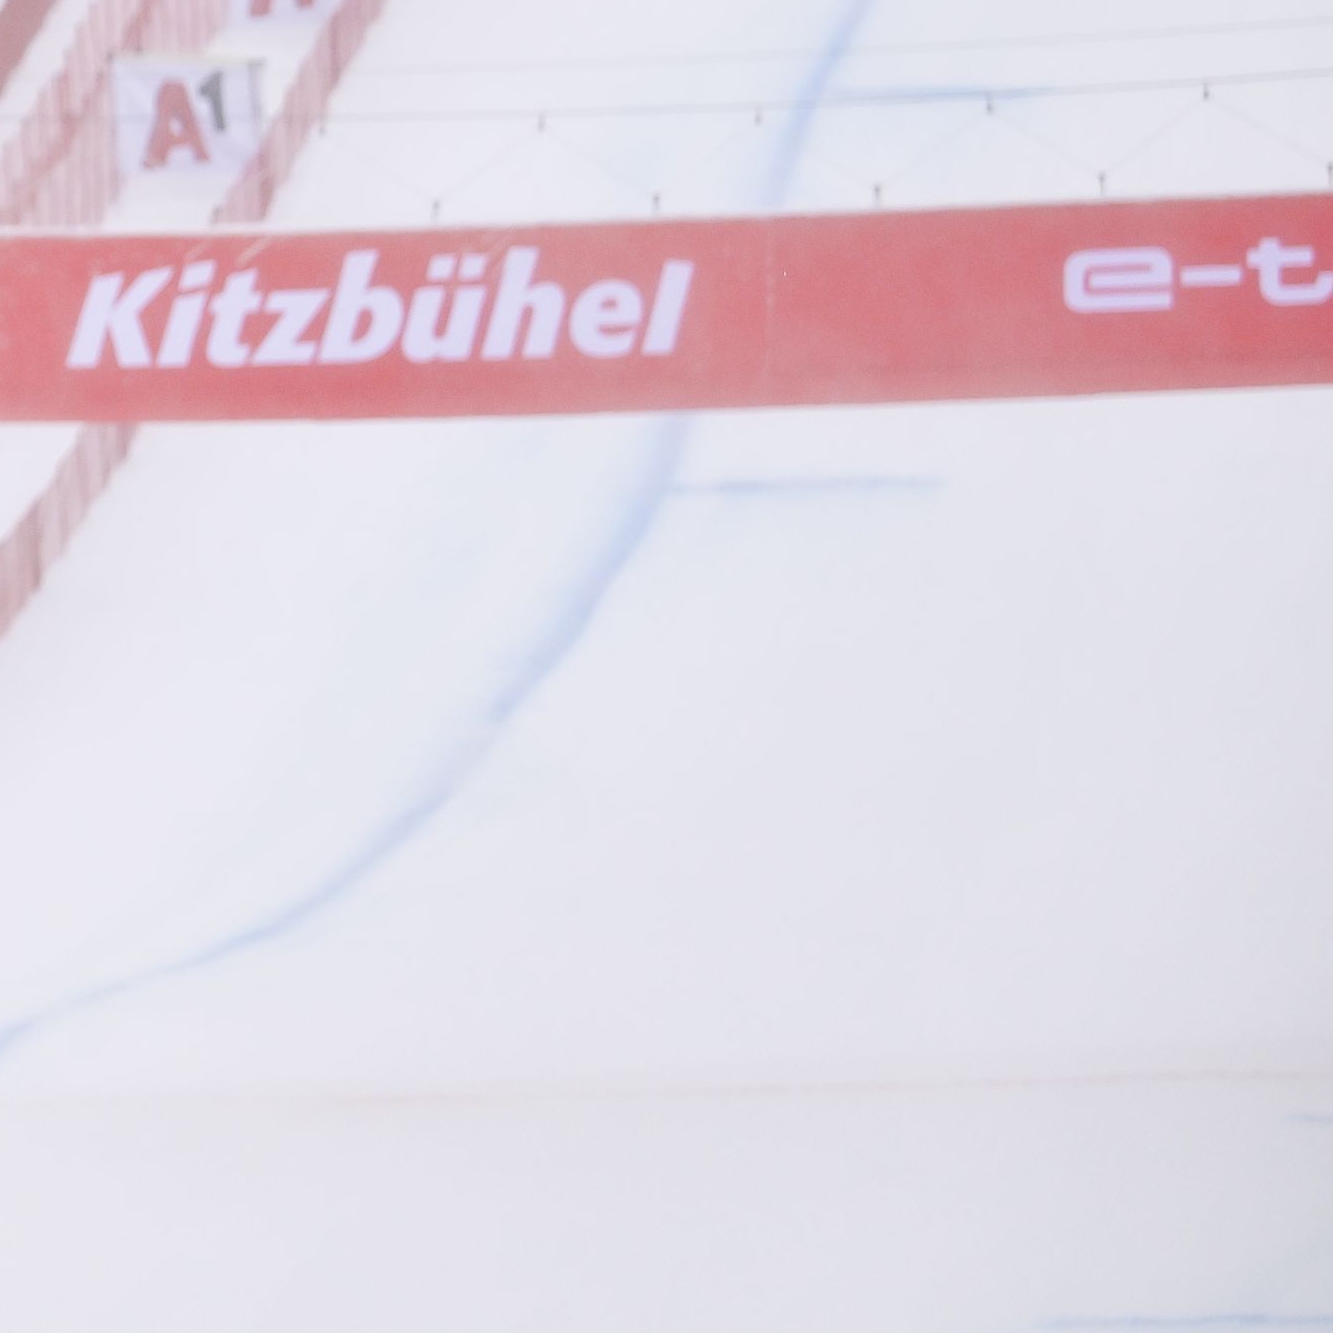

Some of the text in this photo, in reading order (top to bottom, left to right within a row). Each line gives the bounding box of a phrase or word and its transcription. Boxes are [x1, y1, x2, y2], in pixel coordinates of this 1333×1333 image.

[143, 72, 228, 169] A1
[65, 246, 695, 368] Kitzbühel
[1062, 235, 1333, 314] e-t
